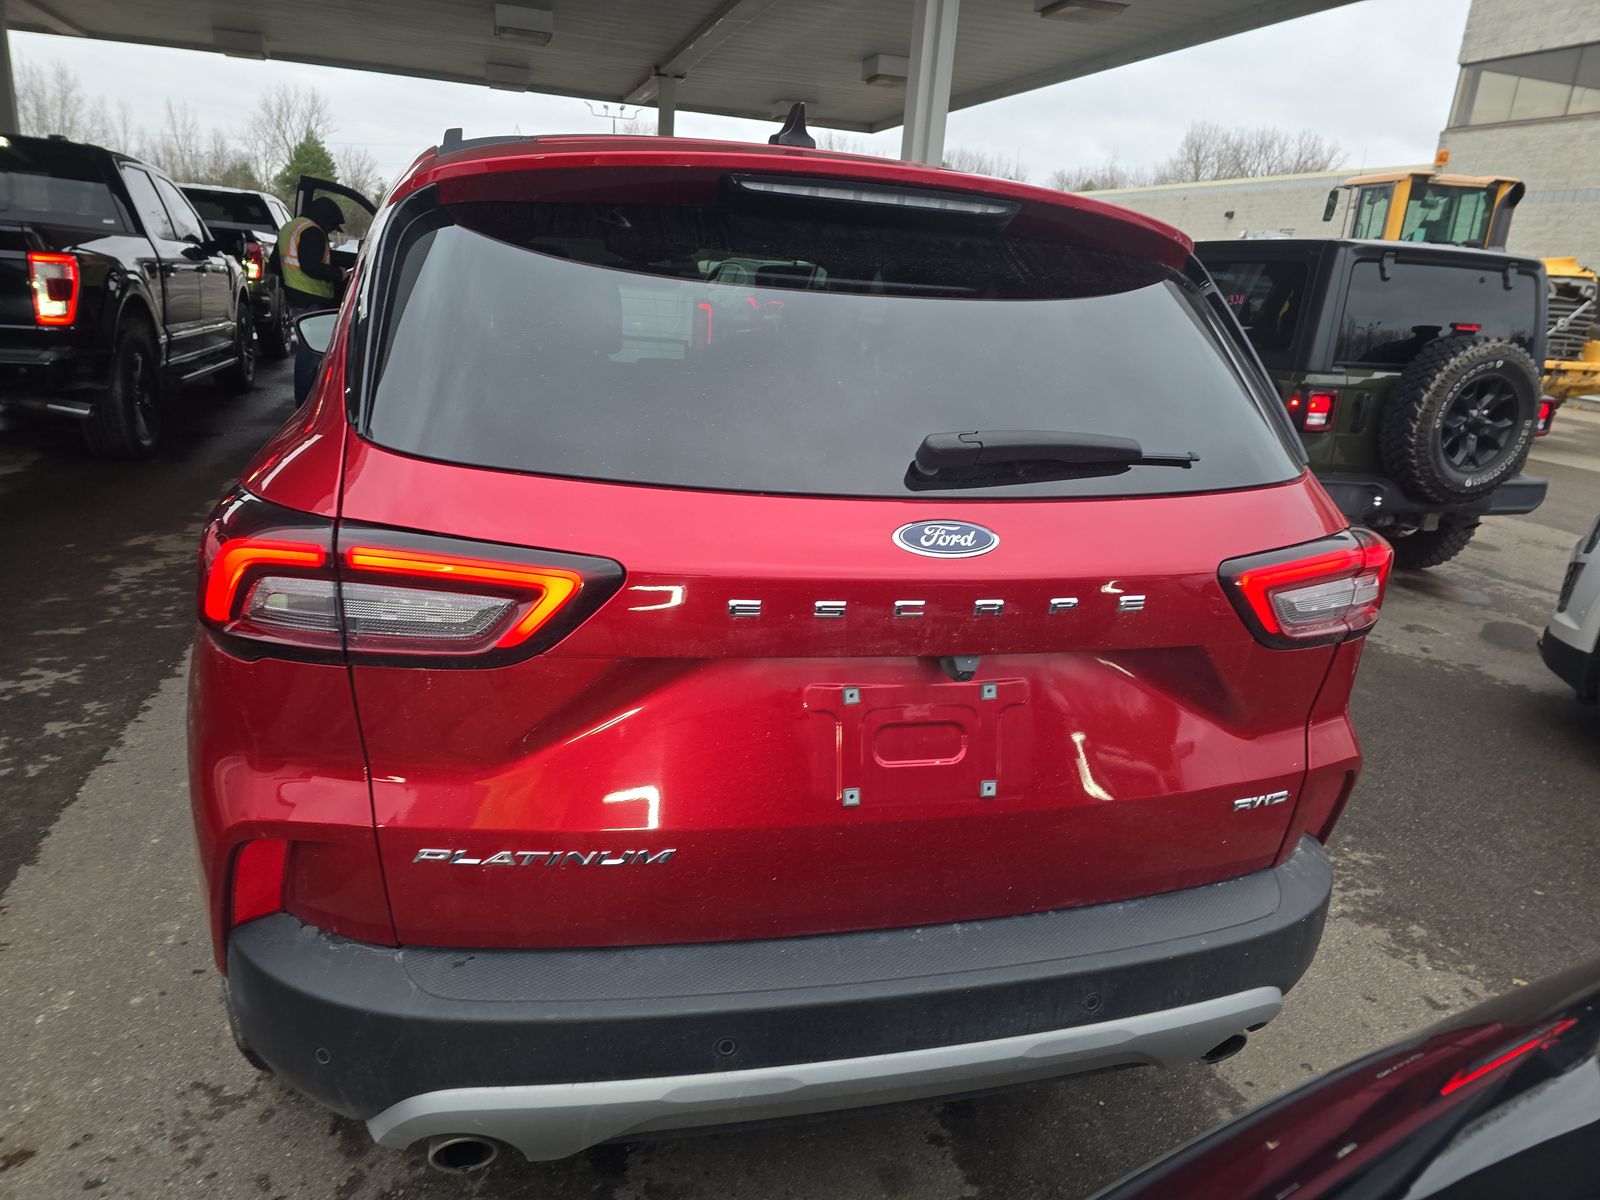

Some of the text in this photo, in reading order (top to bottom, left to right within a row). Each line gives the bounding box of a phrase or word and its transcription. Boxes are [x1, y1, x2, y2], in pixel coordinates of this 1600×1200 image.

[919, 524, 977, 547] Ford
[728, 594, 1146, 617] ESCAPE
[412, 848, 676, 866] PLATINUM
